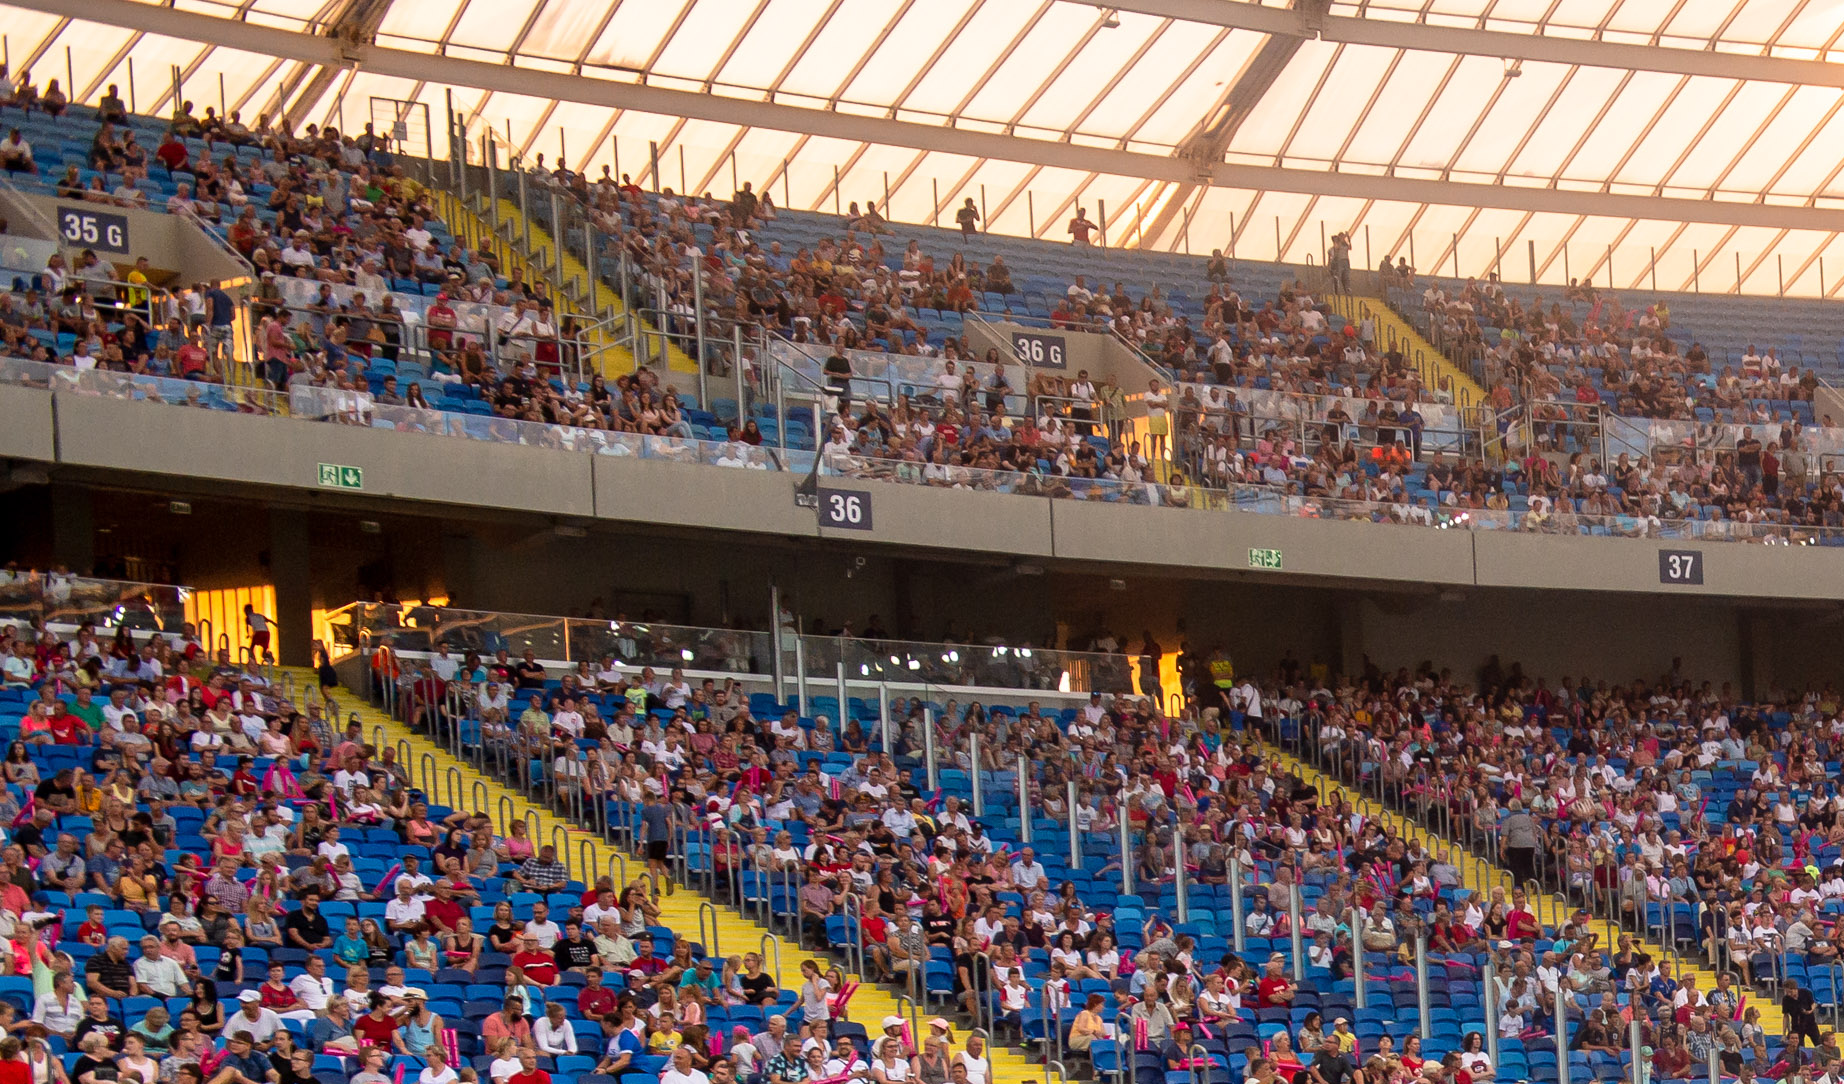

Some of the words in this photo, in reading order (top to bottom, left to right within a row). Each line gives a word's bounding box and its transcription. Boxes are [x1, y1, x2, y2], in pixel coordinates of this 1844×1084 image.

[65, 213, 99, 243] 35
[108, 224, 122, 247] G
[1018, 338, 1043, 362] 36
[1049, 345, 1062, 364] G
[829, 494, 862, 524] 36
[1668, 554, 1694, 579] 37
